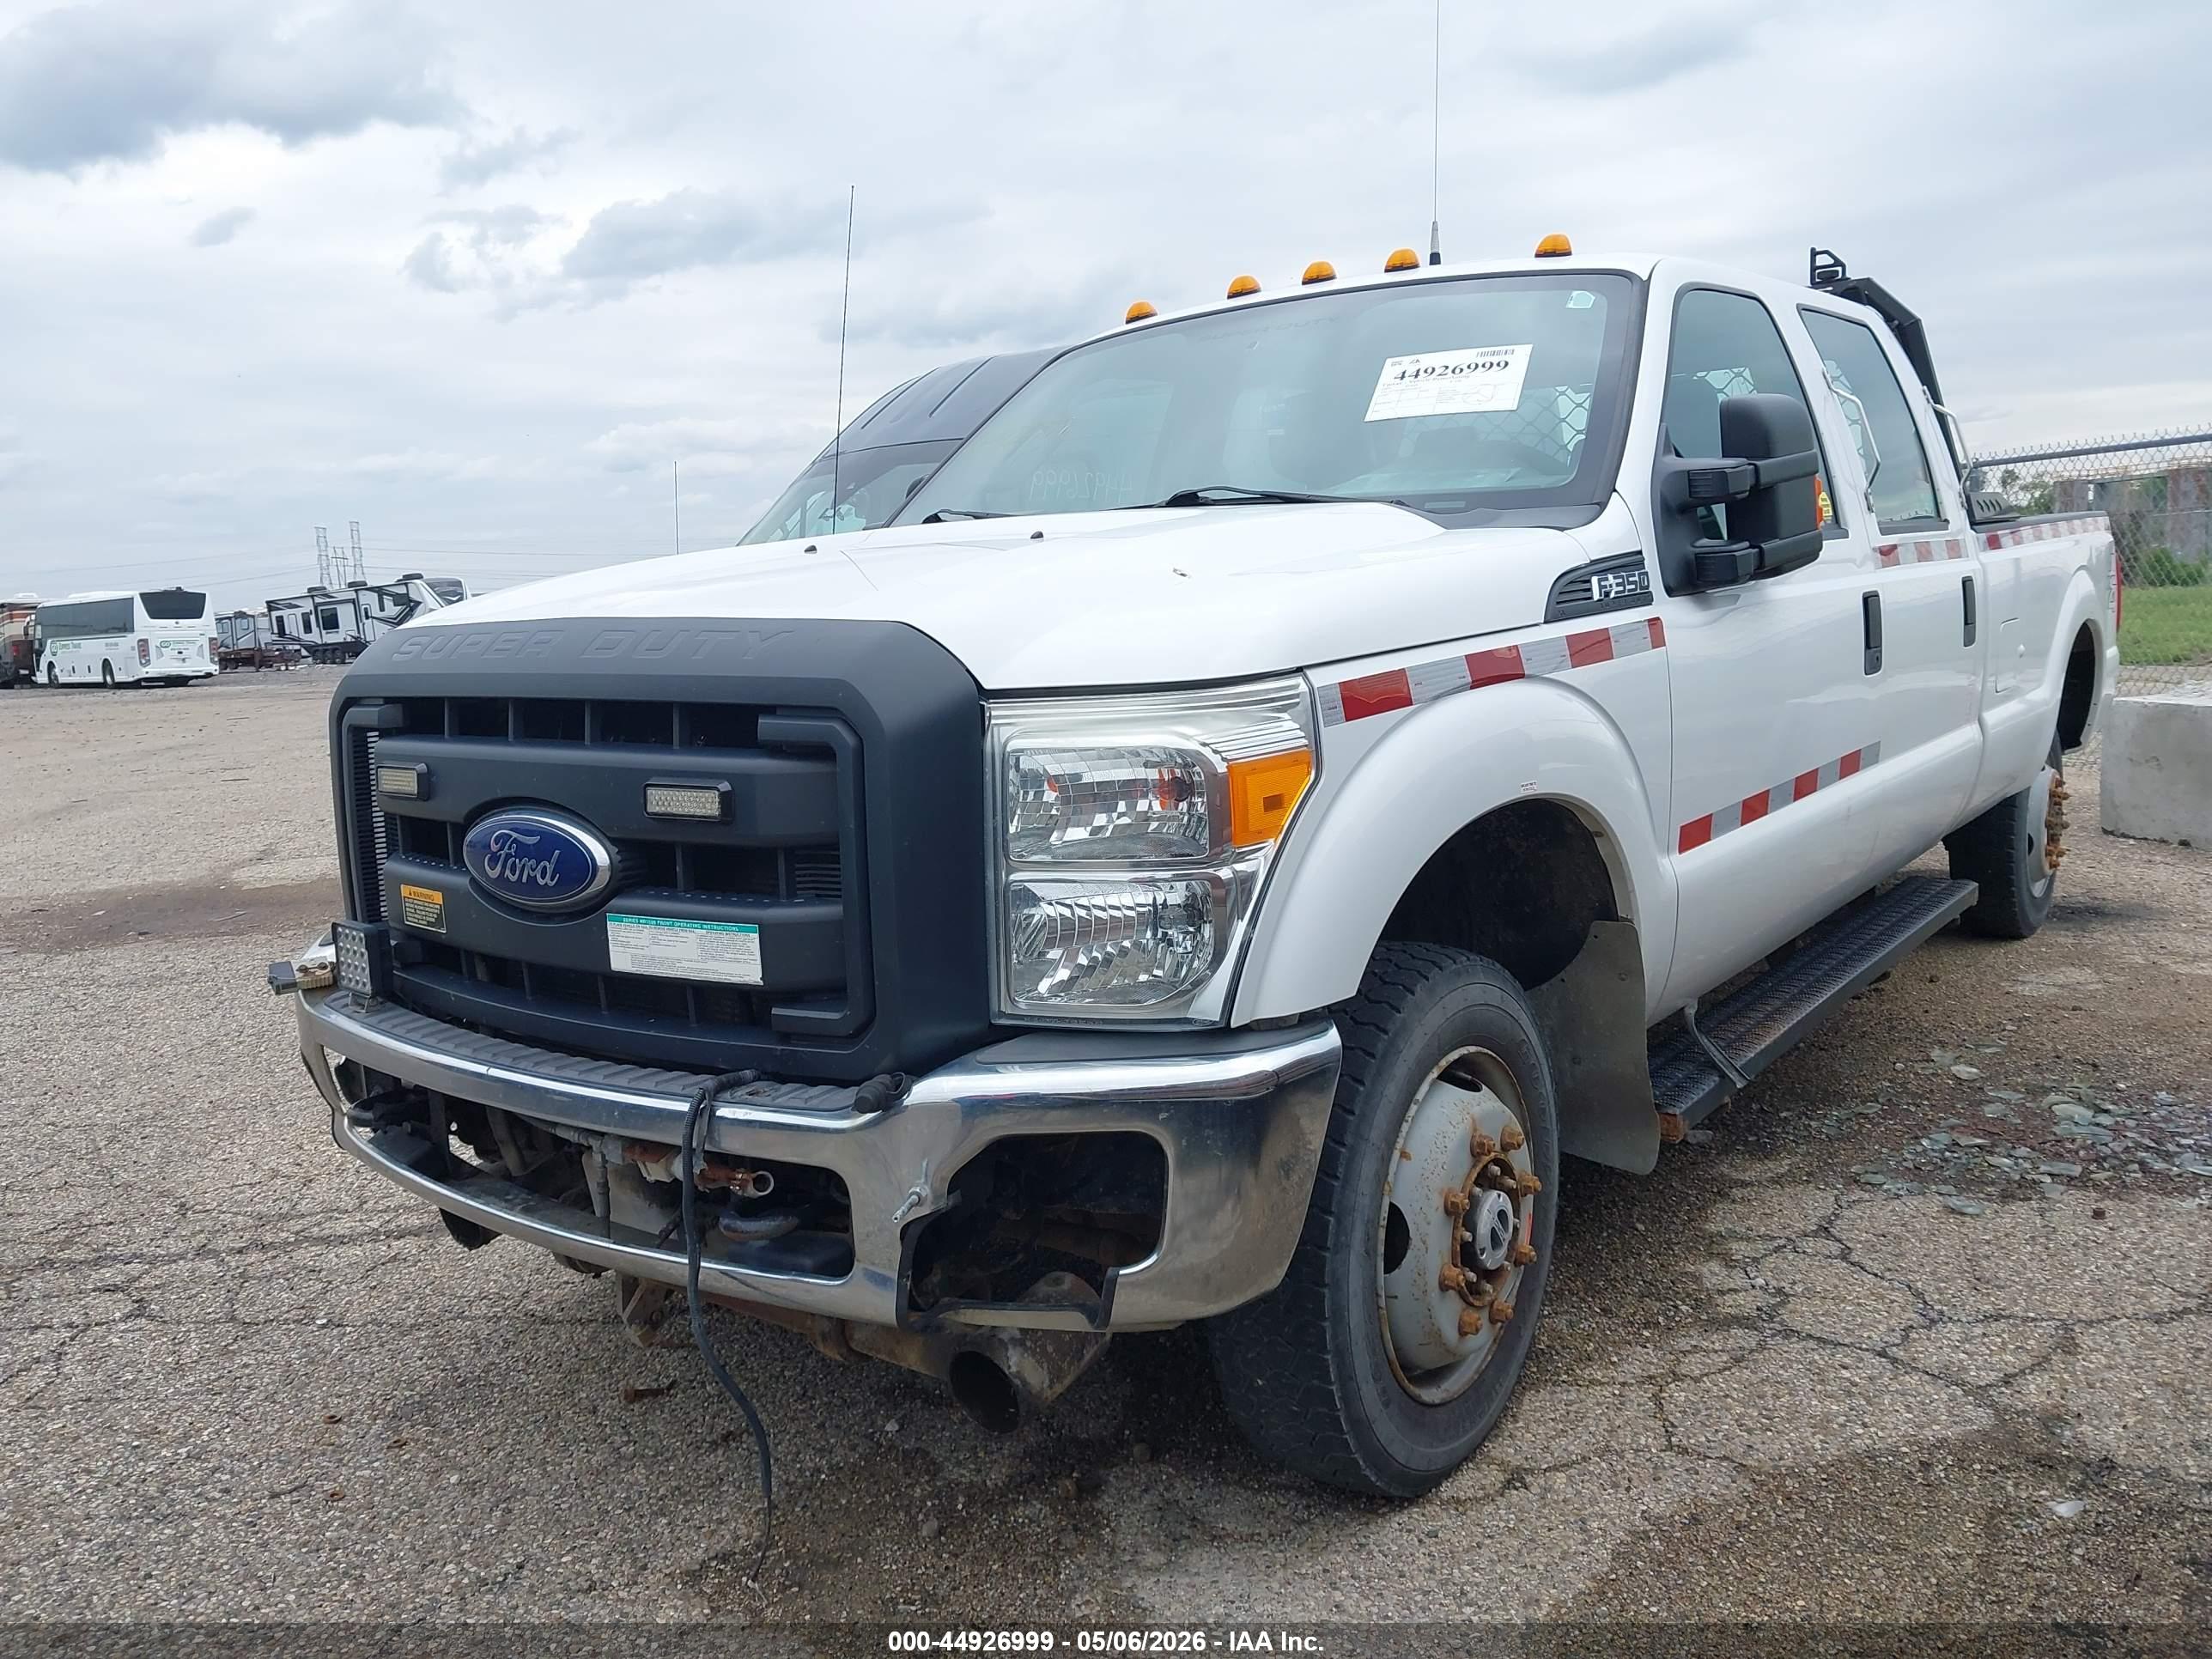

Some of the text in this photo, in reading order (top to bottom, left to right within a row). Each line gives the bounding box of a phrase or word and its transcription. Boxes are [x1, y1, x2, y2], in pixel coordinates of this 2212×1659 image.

[1395, 359, 1510, 381] 44926999
[392, 629, 796, 662] SUPER DUTY
[484, 830, 561, 887] Ford
[673, 921, 701, 929] OPERATING
[702, 923, 739, 932] INSTRUCTIONS
